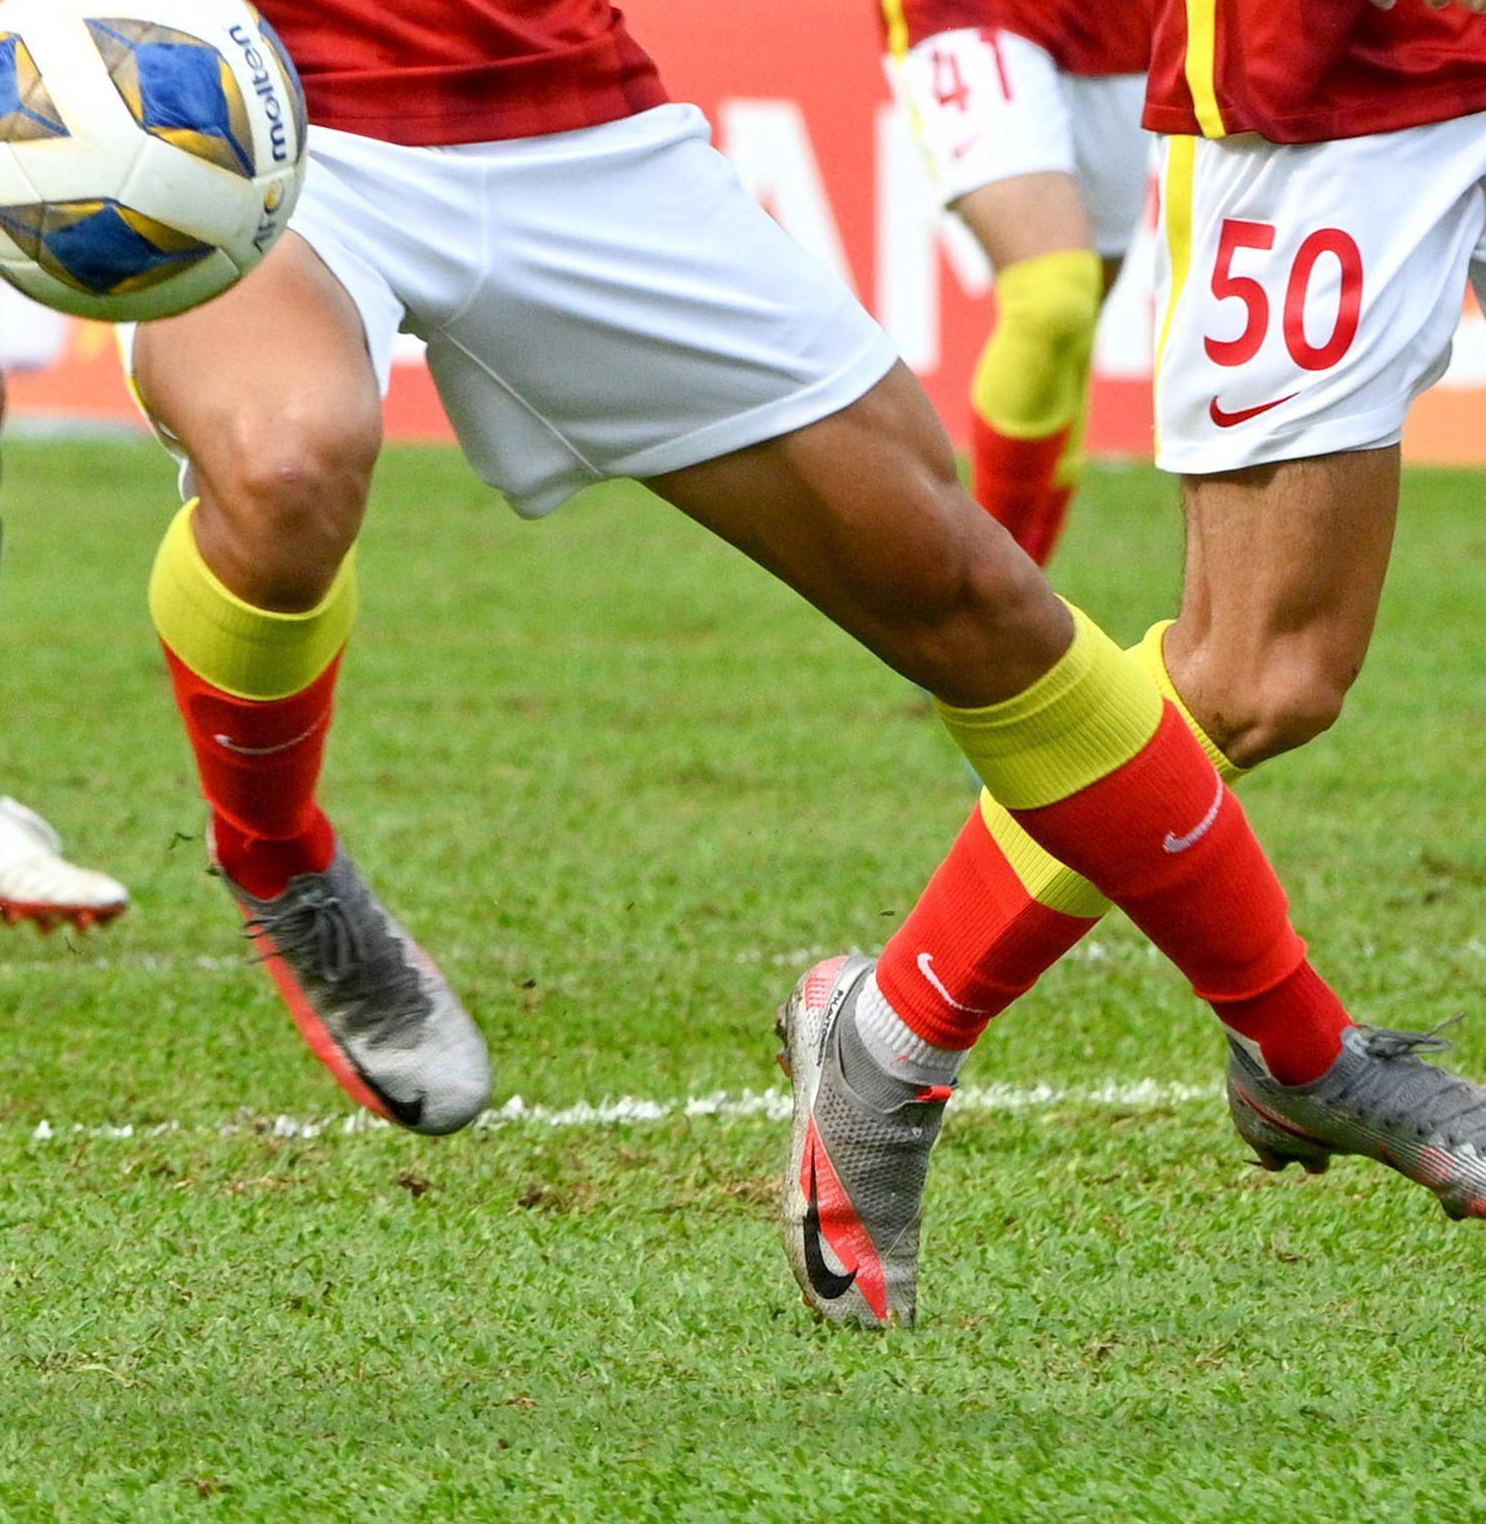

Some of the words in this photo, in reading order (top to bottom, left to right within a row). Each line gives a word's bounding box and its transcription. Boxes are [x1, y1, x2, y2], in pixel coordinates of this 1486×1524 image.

[229, 24, 287, 163] molten
[931, 27, 1012, 113] 41
[1203, 219, 1365, 372] 50
